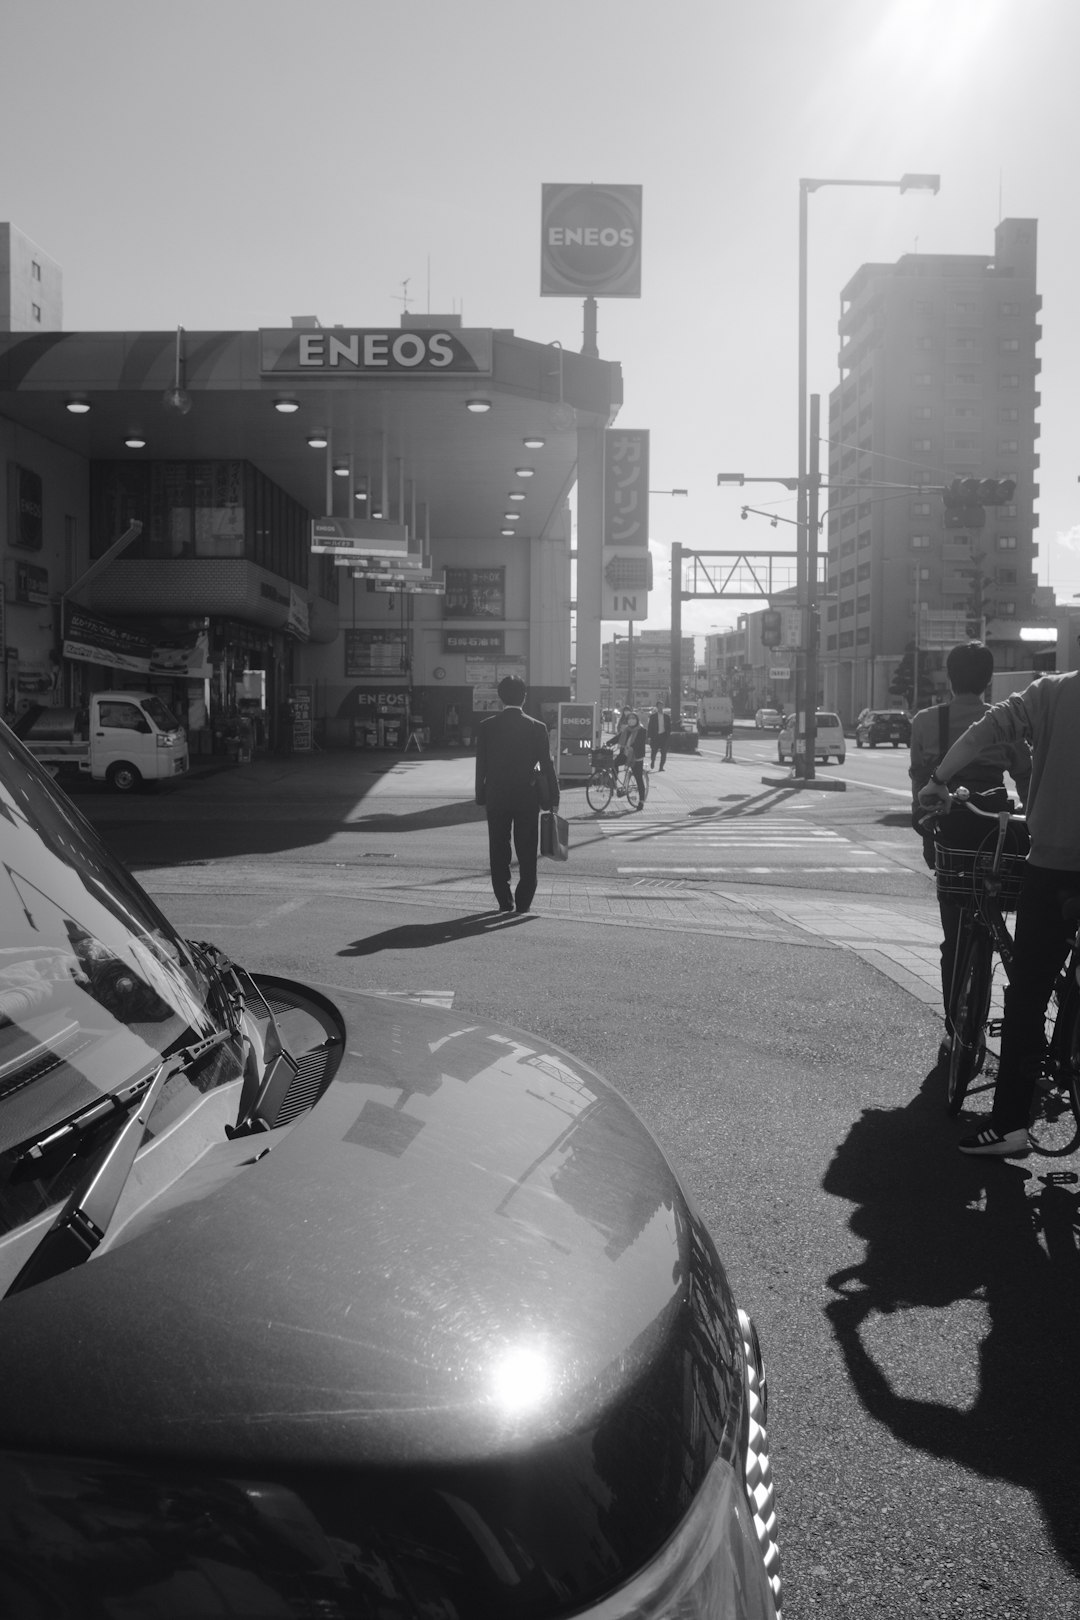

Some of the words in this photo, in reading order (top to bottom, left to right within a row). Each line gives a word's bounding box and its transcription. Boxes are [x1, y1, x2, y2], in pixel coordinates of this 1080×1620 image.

[548, 227, 634, 248] ENEOS
[299, 333, 454, 367] ENEOS
[612, 436, 642, 540] ガソリン
[316, 525, 336, 533] ENEOS
[613, 596, 637, 612] IN
[358, 693, 406, 705] ENEOS
[562, 717, 592, 726] ENEOS
[579, 740, 592, 749] IN
